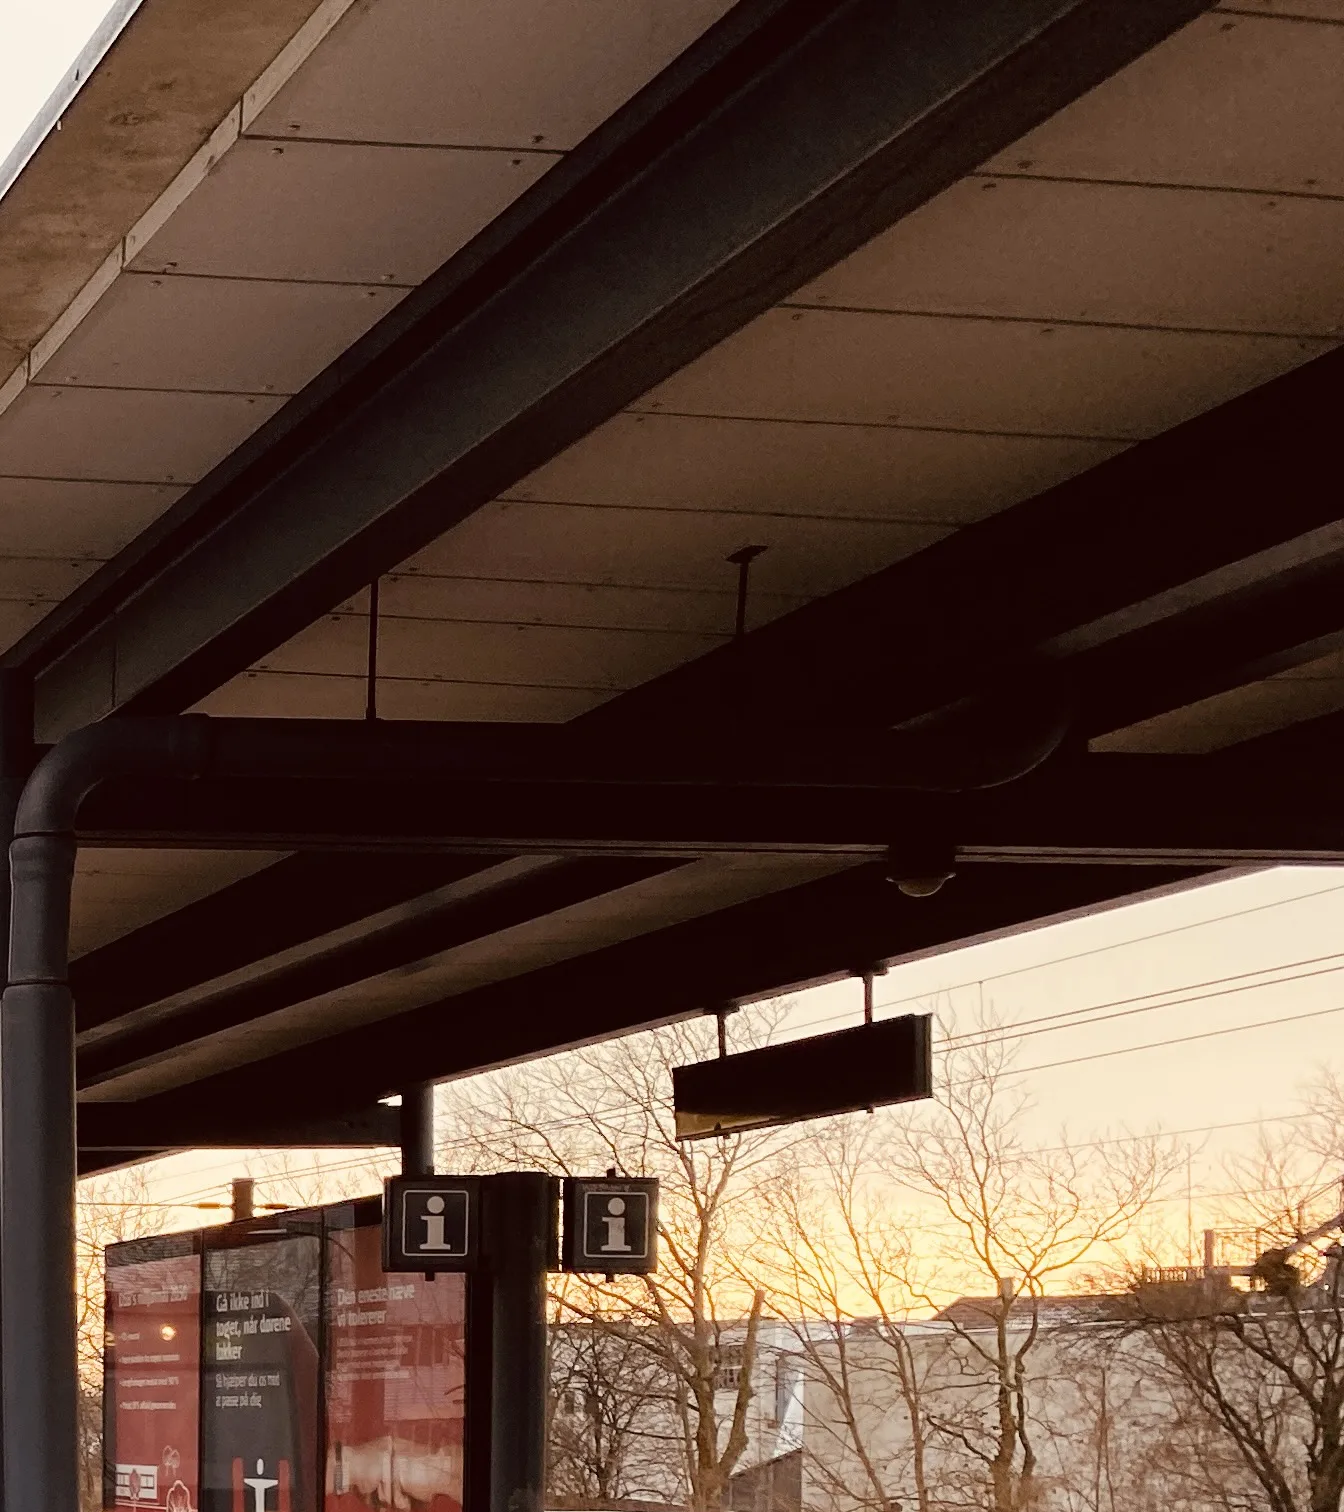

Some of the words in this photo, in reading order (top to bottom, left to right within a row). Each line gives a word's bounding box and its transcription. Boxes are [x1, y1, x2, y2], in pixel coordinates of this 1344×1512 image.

[216, 1292, 228, 1313] Gå
[229, 1290, 250, 1311] ikke
[250, 1288, 265, 1310] ind
[216, 1320, 242, 1340] toget,
[243, 1314, 258, 1335] når
[259, 1313, 292, 1334] dørene
